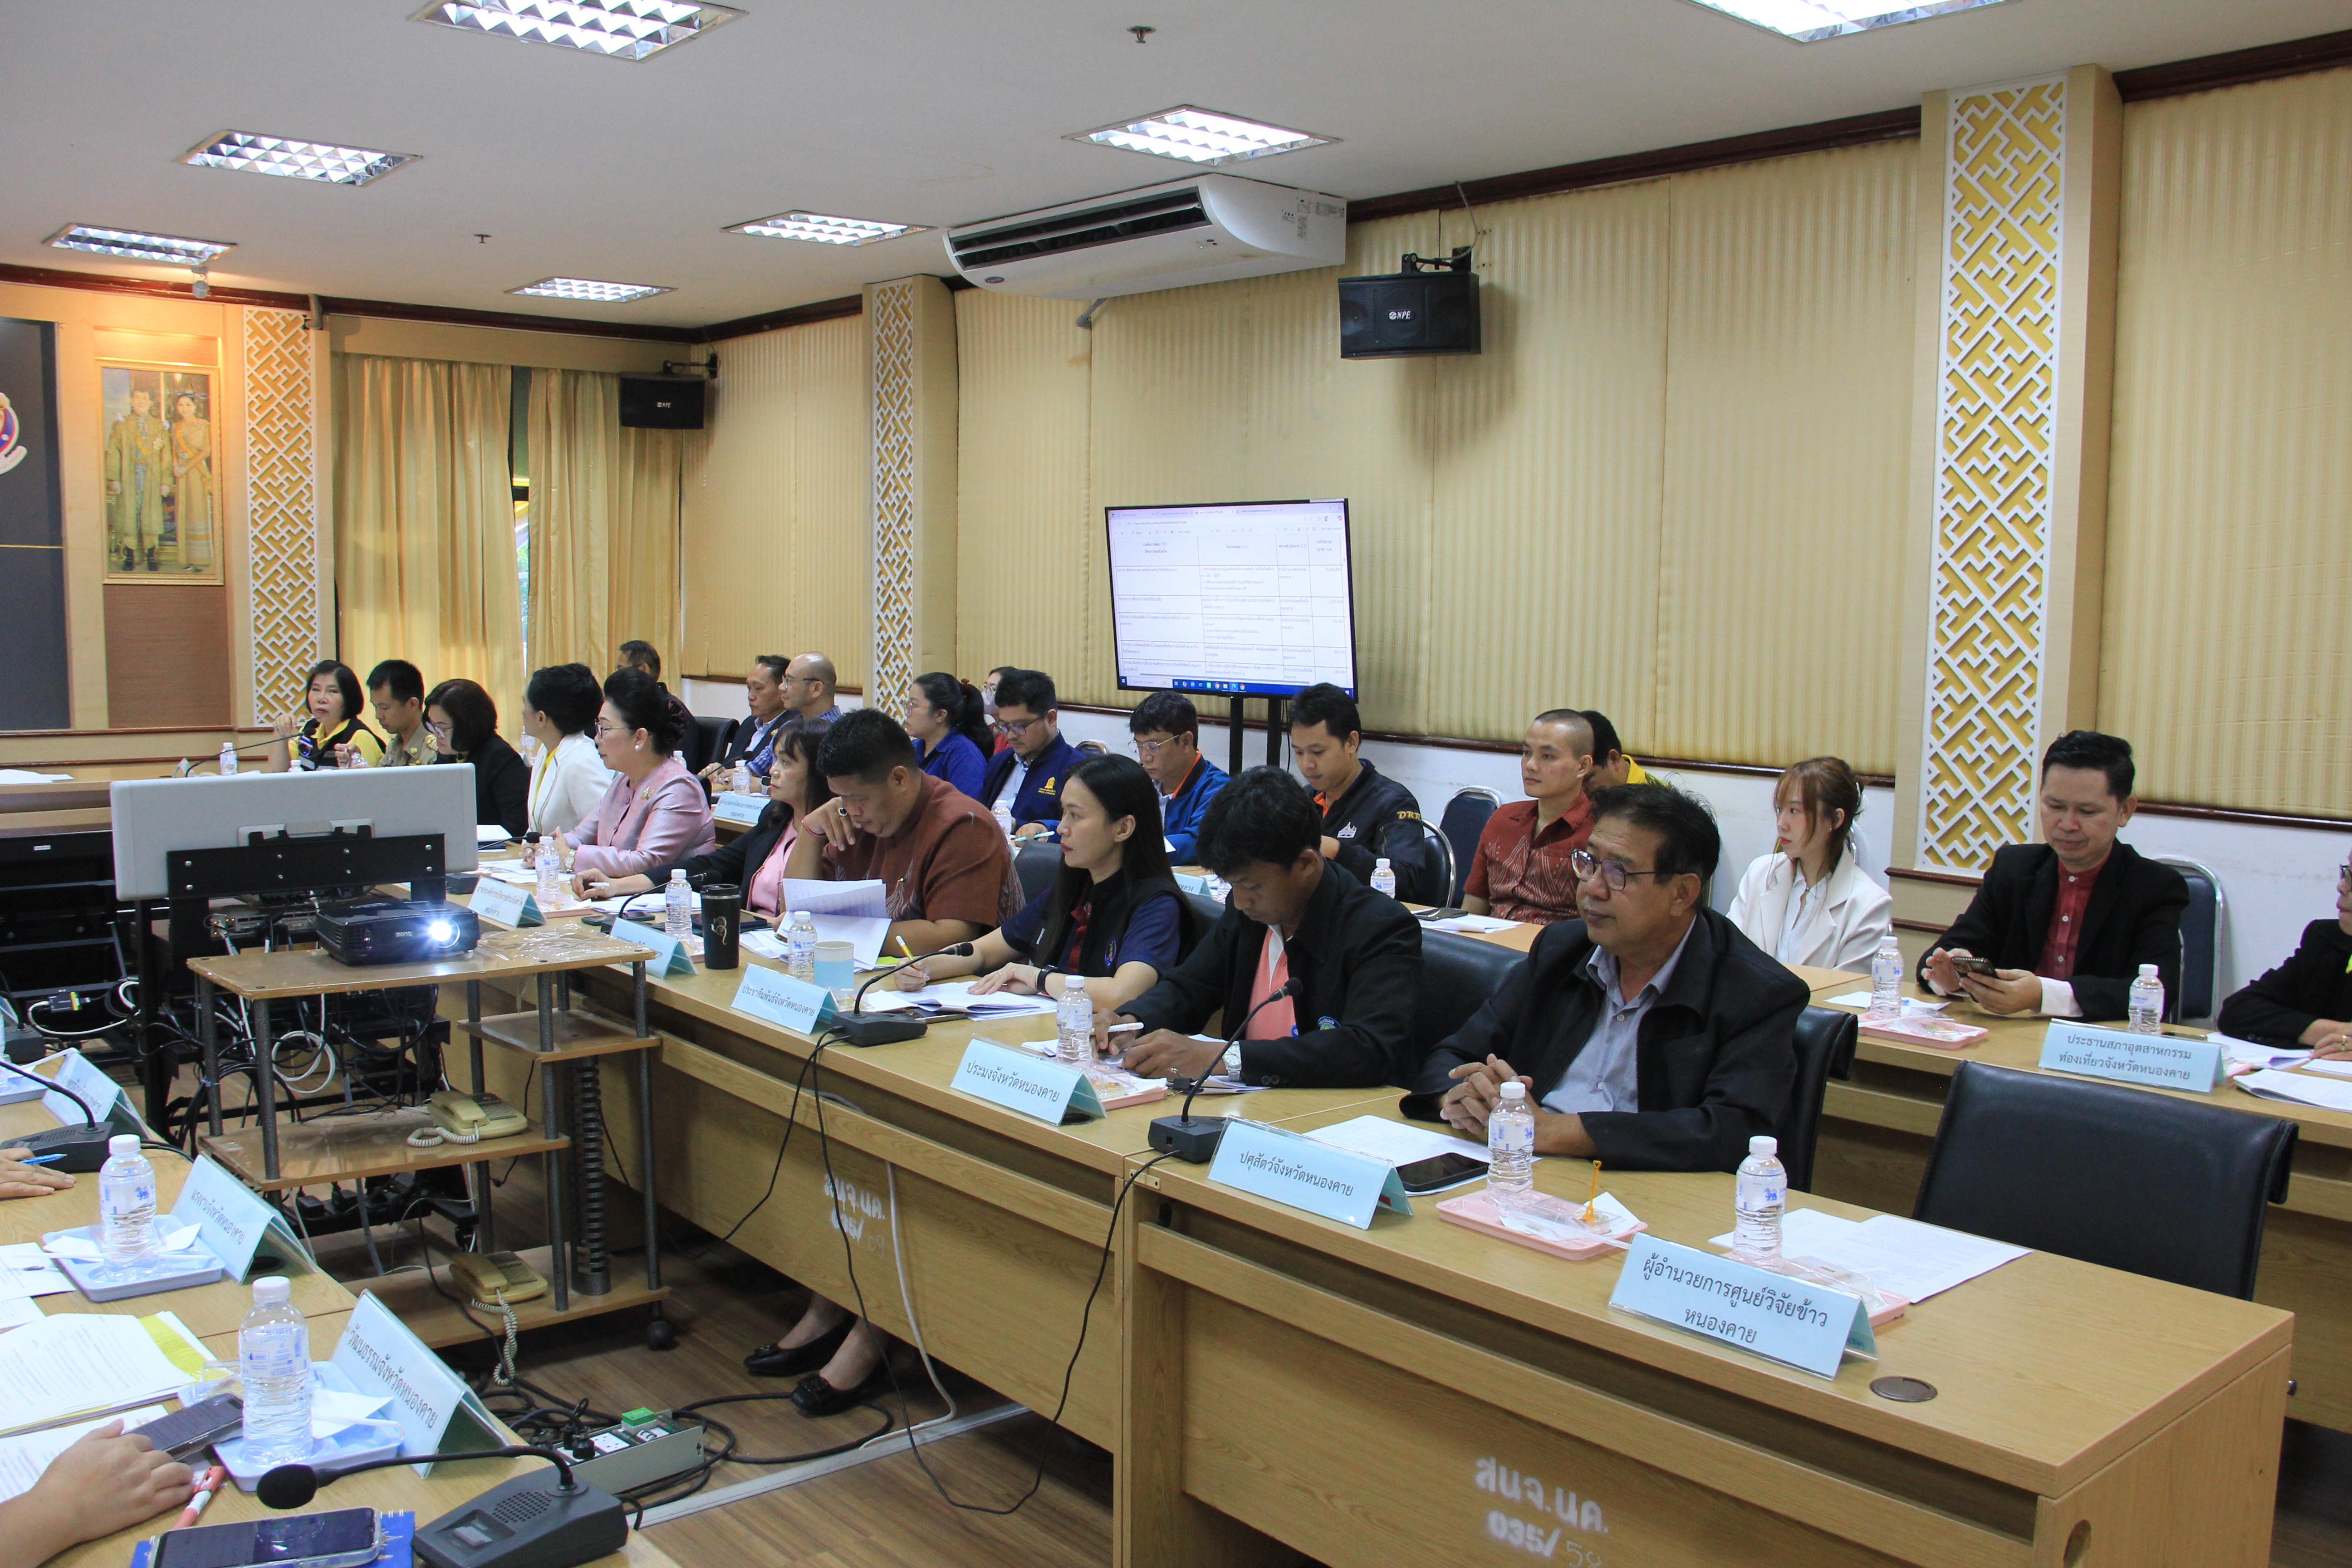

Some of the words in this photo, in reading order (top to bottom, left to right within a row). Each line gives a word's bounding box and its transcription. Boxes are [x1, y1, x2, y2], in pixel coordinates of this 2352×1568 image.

[1397, 310, 1411, 319] NPE
[742, 985, 816, 1017] ประชาสัมพันธ์จังหวัดหนองคาย
[2058, 1051, 2190, 1081] ท่องเที่ยวจังหวัดหนองคาย
[2067, 1034, 2191, 1060] ประธานสภาอุตสาหกรรม
[966, 1060, 1061, 1102] ประมงจังหวัดหนองคาย
[1240, 1150, 1354, 1196] ปศุสัตว์จังหวัดหนองคาย
[191, 1189, 246, 1245] แรงงานจังหวัดหนองคาย
[1642, 1252, 1828, 1328] ผู้อำนวยการศูนย์วิจัยข้าว
[1684, 1307, 1758, 1344] หนองคาย
[348, 1323, 438, 1429] วัฒนธรรมจังหวัดหนองคาย
